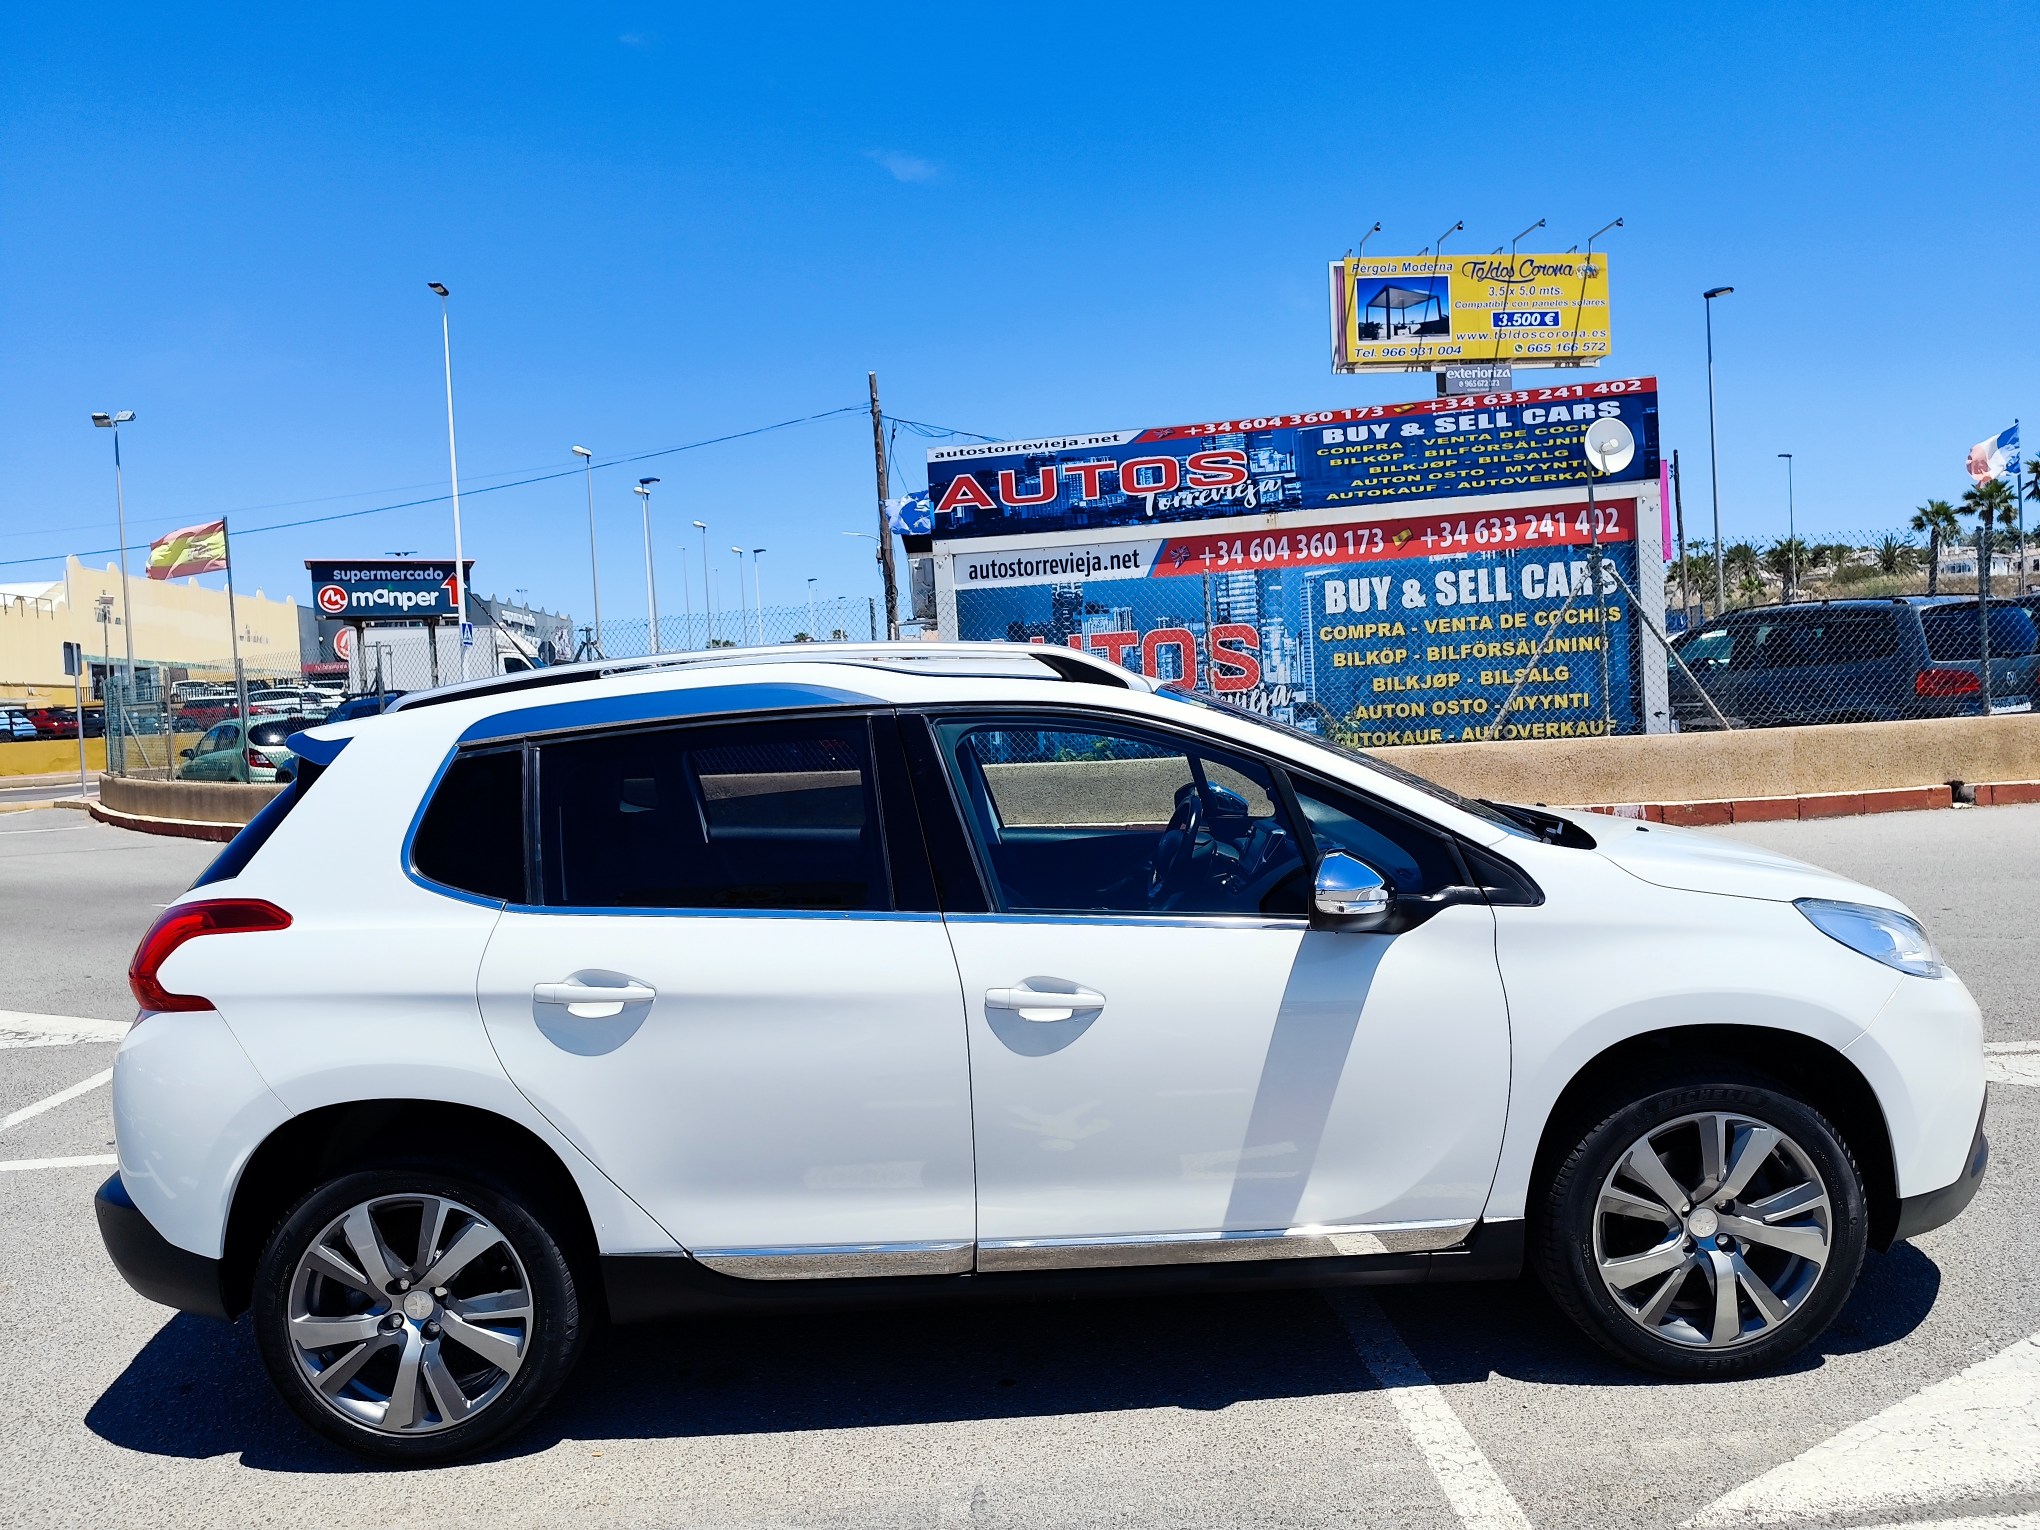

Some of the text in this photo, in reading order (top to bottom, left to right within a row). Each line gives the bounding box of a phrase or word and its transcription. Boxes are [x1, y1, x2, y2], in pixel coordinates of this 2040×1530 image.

[1401, 262, 1453, 273] Moderna
[1519, 259, 1574, 279] Corona
[1454, 300, 1509, 310] Compatible
[1532, 299, 1569, 308] paneles
[1571, 298, 1606, 307] solares
[1509, 287, 1515, 296] x
[1498, 313, 1556, 327] 3.500 €
[1456, 329, 1607, 341] www.toldoscorona.es
[1527, 342, 1606, 353] 665 166 572
[1354, 345, 1462, 358] Tel. 966 931 004
[1446, 366, 1512, 379] exterioriza
[1424, 380, 1641, 411] +34 633 241 402
[1184, 405, 1384, 436] +34 604 360 173
[1322, 400, 1621, 444] BUY & SELL CARS
[934, 432, 1121, 459] autostorrevieja.net
[1316, 441, 1403, 456] COMPRA
[1422, 433, 1492, 446] VENTA
[1499, 429, 1528, 440] DE
[1534, 423, 1590, 436] COCH
[1329, 453, 1405, 467] BILKÖP
[1424, 435, 1586, 458] BILFÖRSÄLJNI
[1350, 474, 1421, 487] AUTON
[1428, 468, 1485, 480] OSTO
[1505, 459, 1588, 474] MYYNTI
[1369, 459, 1458, 475] BILKJØP
[1478, 449, 1570, 465] BILSALG
[933, 448, 1249, 514] AUTOS
[1326, 484, 1438, 501] AUTOKAUF
[1138, 477, 1283, 517] Torrevieja
[1421, 506, 1621, 549] +34 633 241 402
[1199, 527, 1385, 567] +34 604 360 173
[333, 566, 444, 583] supermercado
[967, 548, 1141, 581] autostorrevieja.net
[351, 588, 440, 611] manper
[1324, 575, 1392, 614] BUY
[1401, 578, 1427, 610] &
[1435, 566, 1513, 606] SELL
[1319, 621, 1406, 642] COMPRA
[1423, 615, 1494, 634] VENTA
[1500, 612, 1528, 629] DE
[1333, 647, 1408, 667] BILKÖP
[1372, 672, 1461, 692] BILKJØP
[1480, 665, 1570, 686] BILSALG
[1356, 702, 1425, 720] AUTON
[1431, 697, 1489, 716] OSTO
[1509, 692, 1590, 711] MYYNTI
[1346, 728, 1442, 747] UTOKAUF
